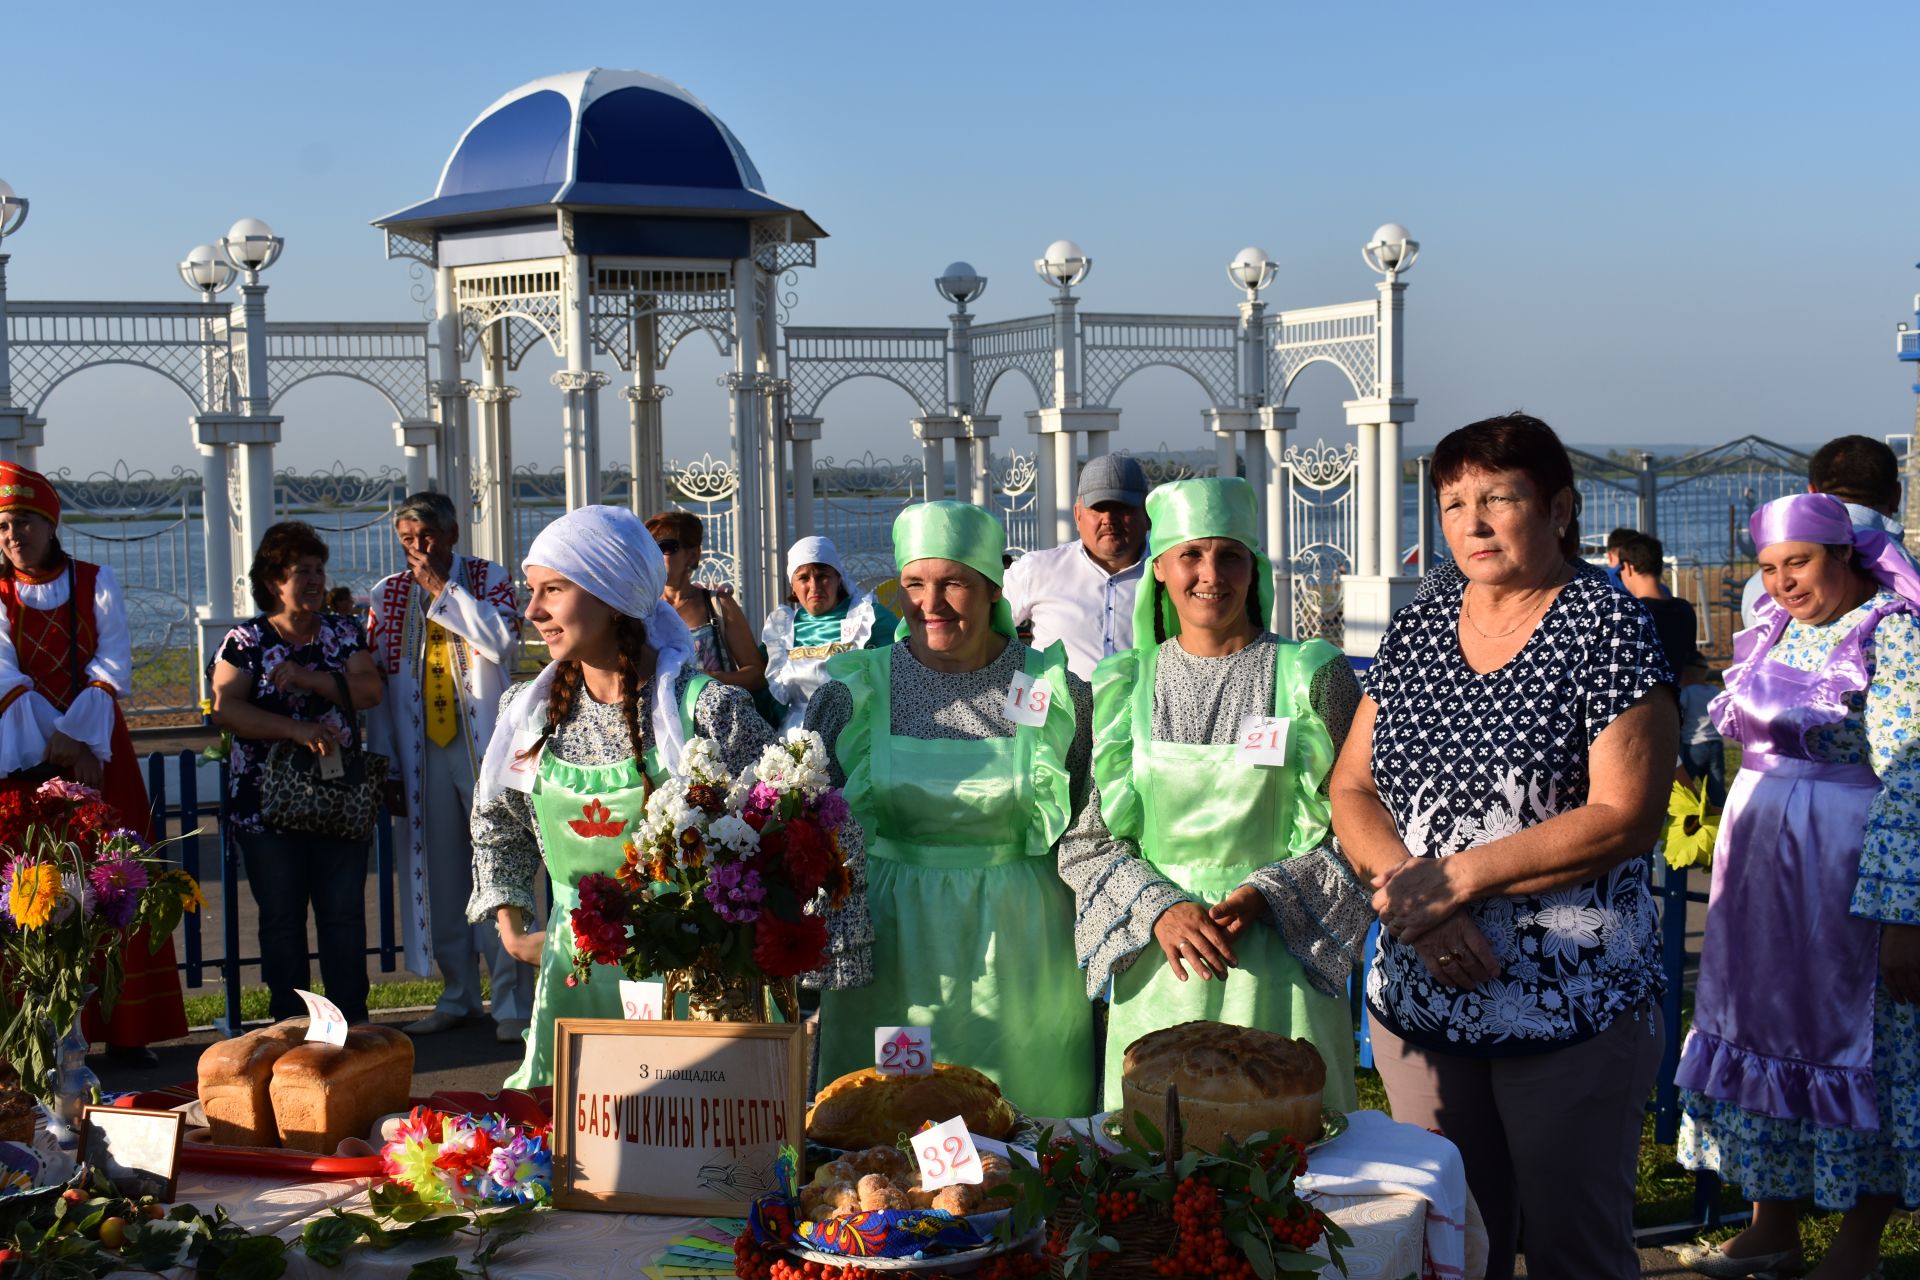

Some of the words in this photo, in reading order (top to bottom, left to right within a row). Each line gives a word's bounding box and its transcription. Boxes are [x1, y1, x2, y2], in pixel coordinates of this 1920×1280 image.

[1014, 687, 1047, 711] 13
[1245, 730, 1280, 750] 21
[881, 1038, 927, 1069] 25
[639, 1063, 649, 1079] 3
[655, 1068, 726, 1083] ПЛОЩАДКА
[577, 1093, 695, 1149] БАБУШКИНЫ
[701, 1097, 788, 1159] РЕЦЕПТЫ
[923, 1136, 973, 1178] 32
